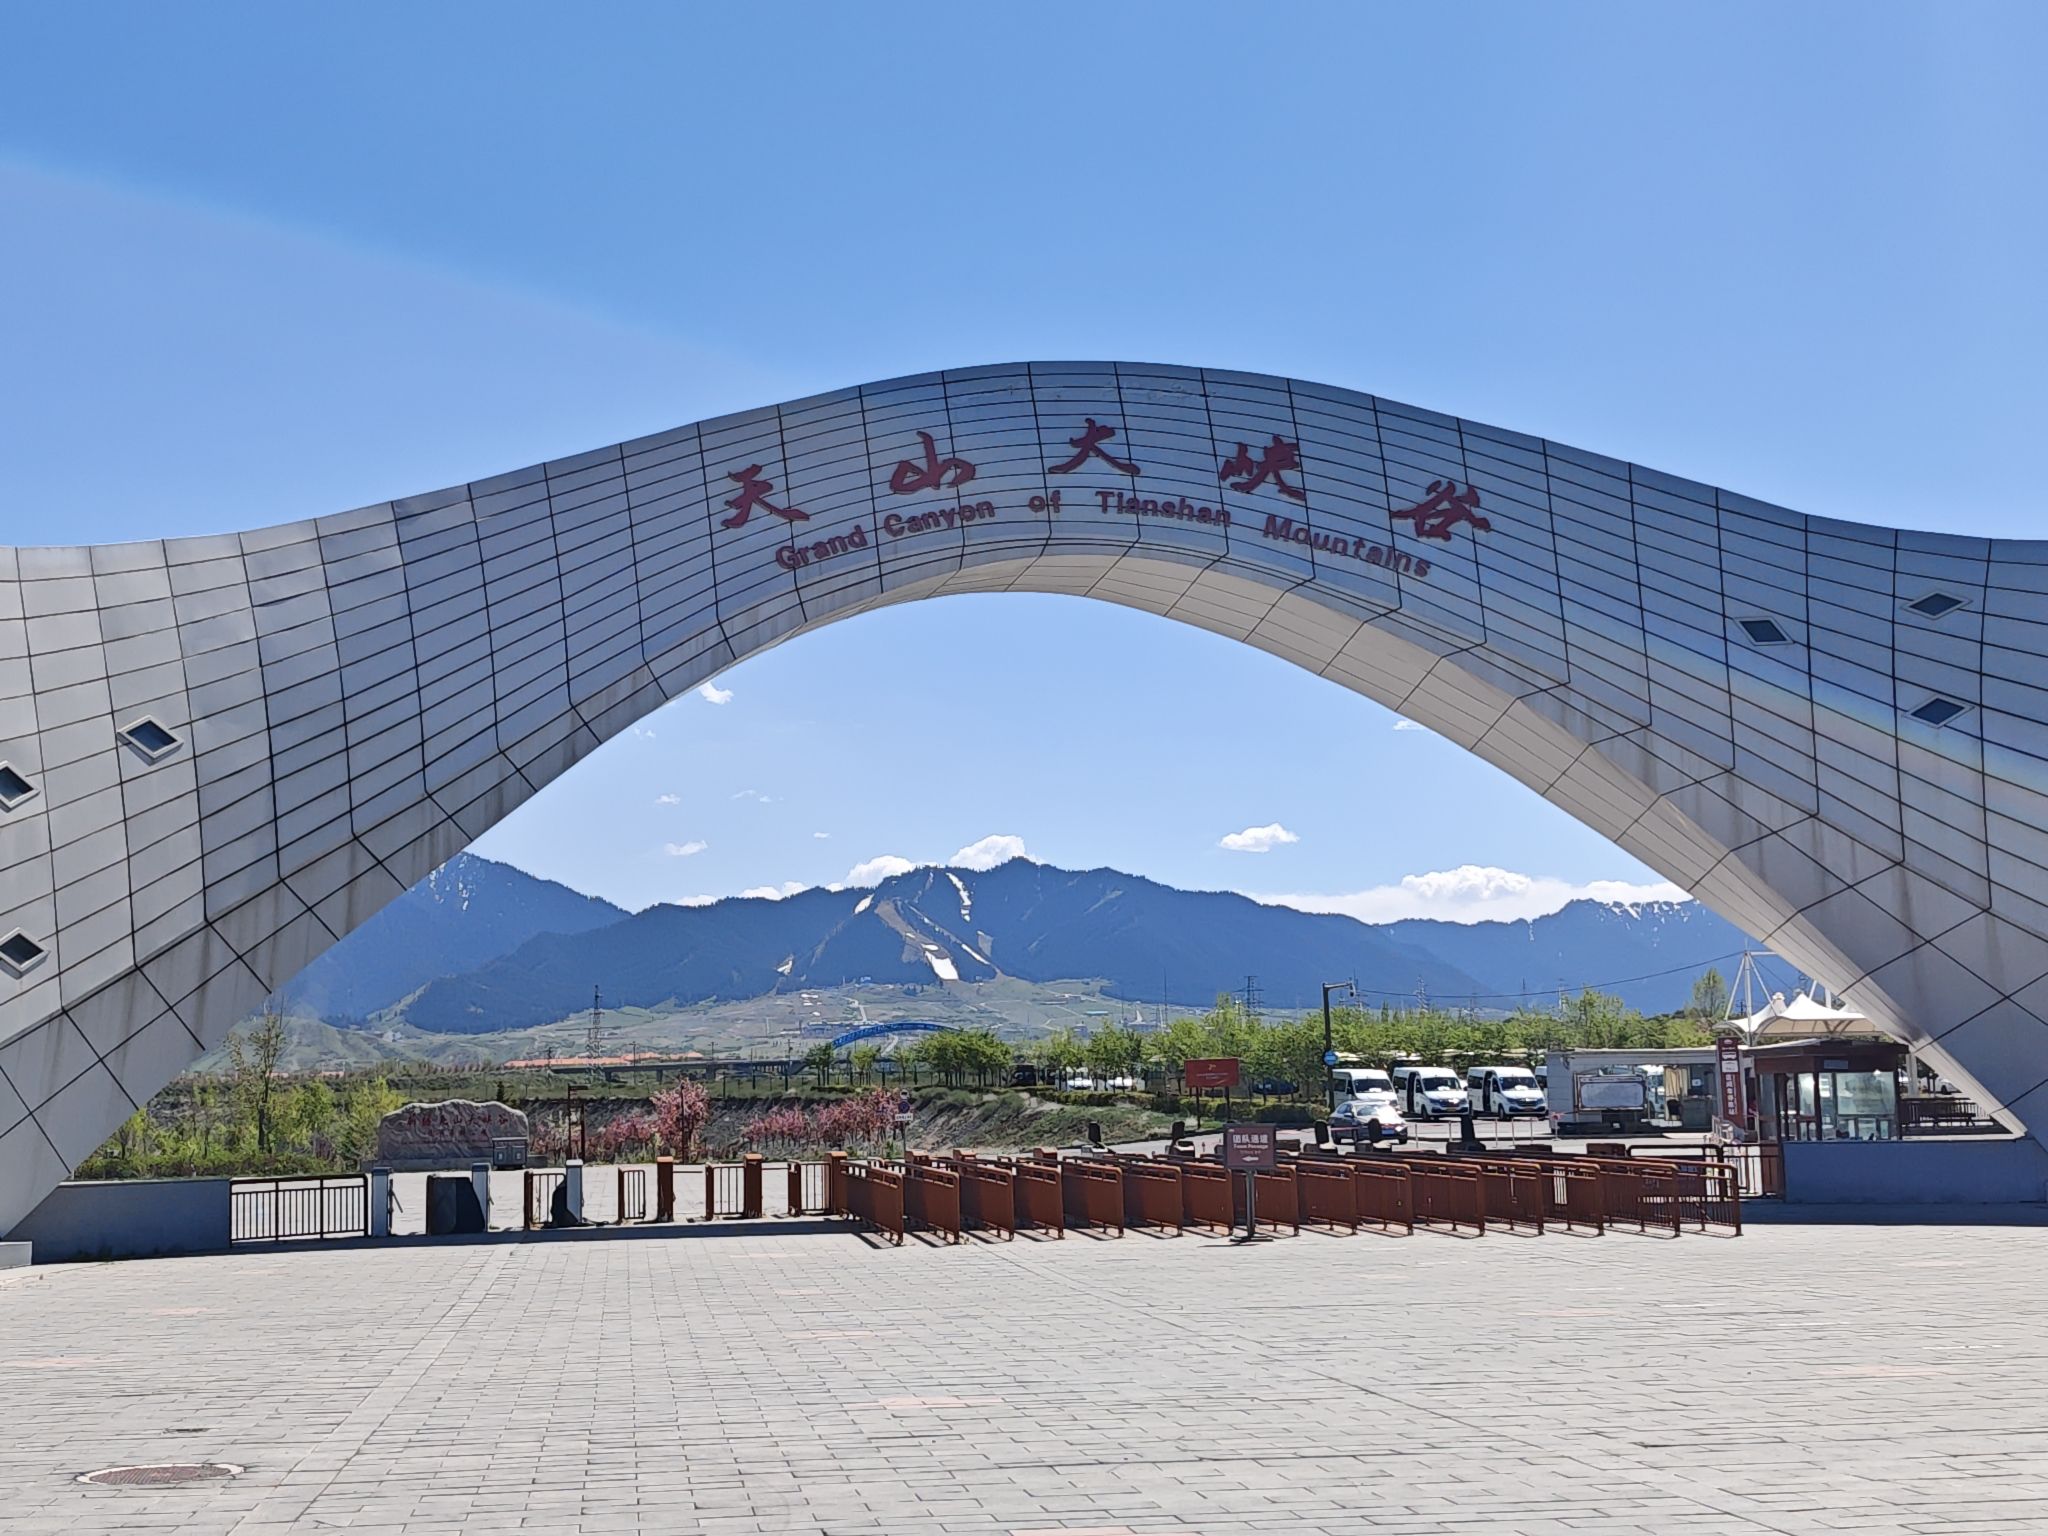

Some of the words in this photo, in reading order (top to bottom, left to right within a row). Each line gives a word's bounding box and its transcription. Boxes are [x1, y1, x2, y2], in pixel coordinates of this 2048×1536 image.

[721, 418, 1491, 541] 天山大峡谷
[776, 524, 868, 569] Grand
[884, 500, 995, 538] Canyon
[1028, 490, 1061, 514] of
[1095, 490, 1231, 527] Tianshan
[1262, 514, 1431, 577] Mountains
